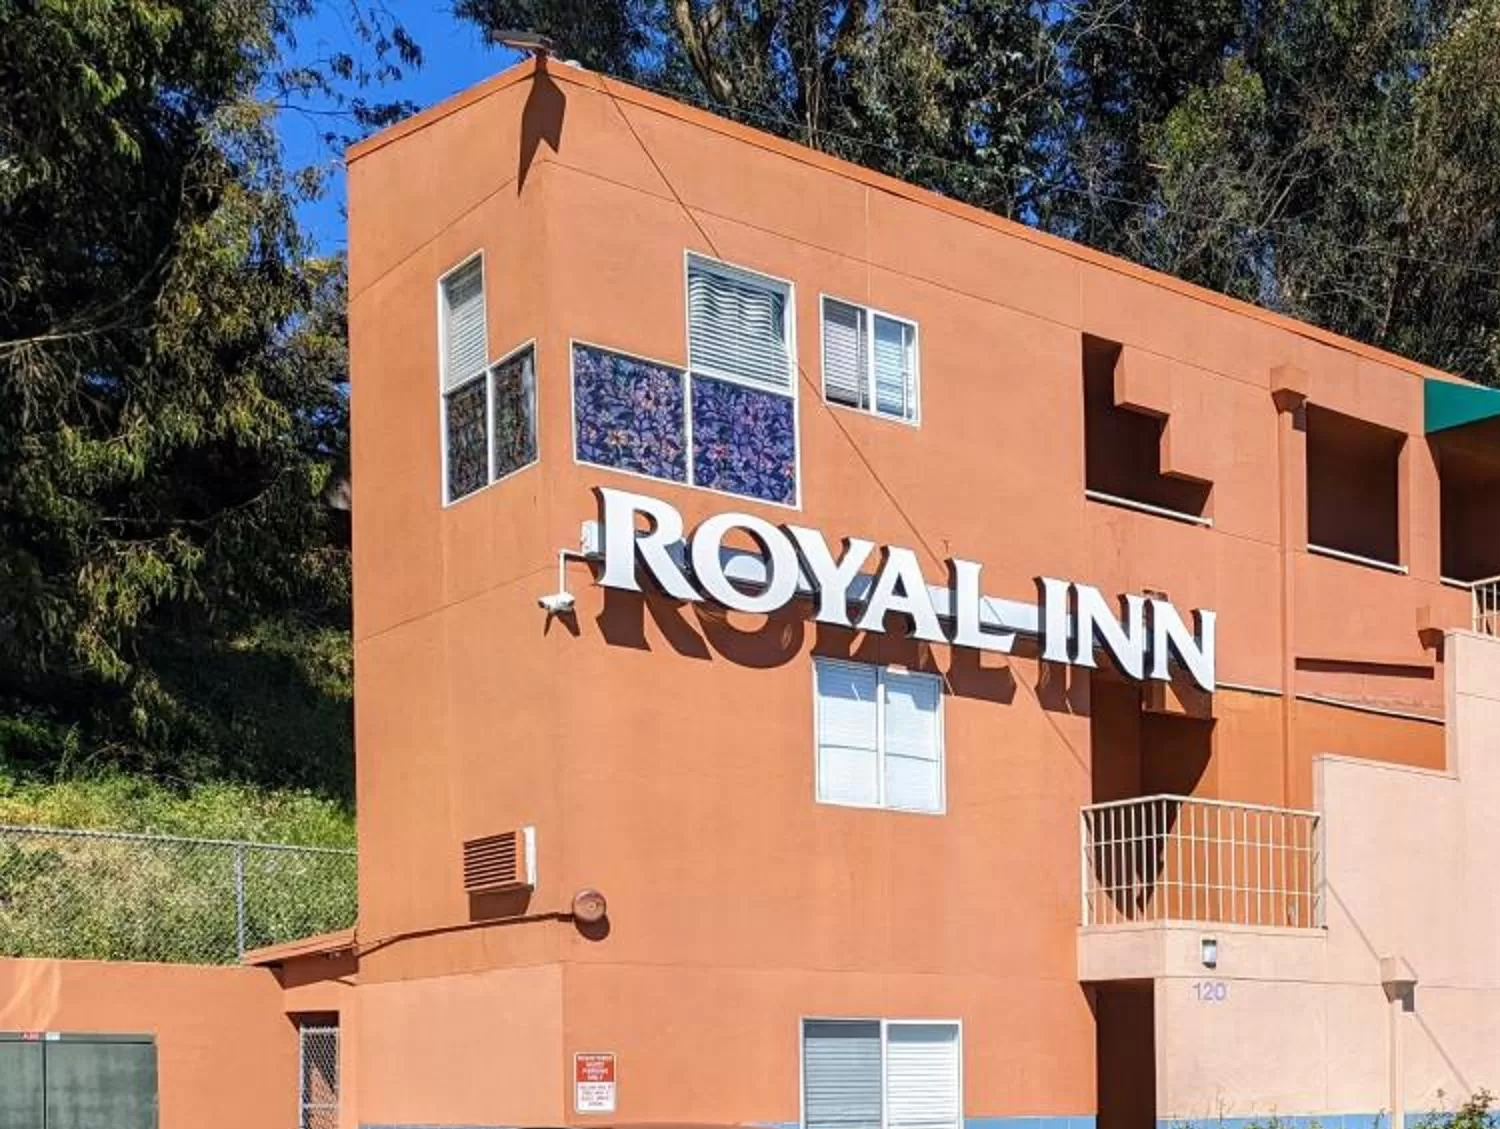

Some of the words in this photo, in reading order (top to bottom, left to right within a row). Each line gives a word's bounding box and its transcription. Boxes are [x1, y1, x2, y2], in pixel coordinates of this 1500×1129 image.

[594, 486, 1015, 653] ROYAL
[1035, 575, 1216, 692] INN
[1192, 982, 1226, 1001] 120
